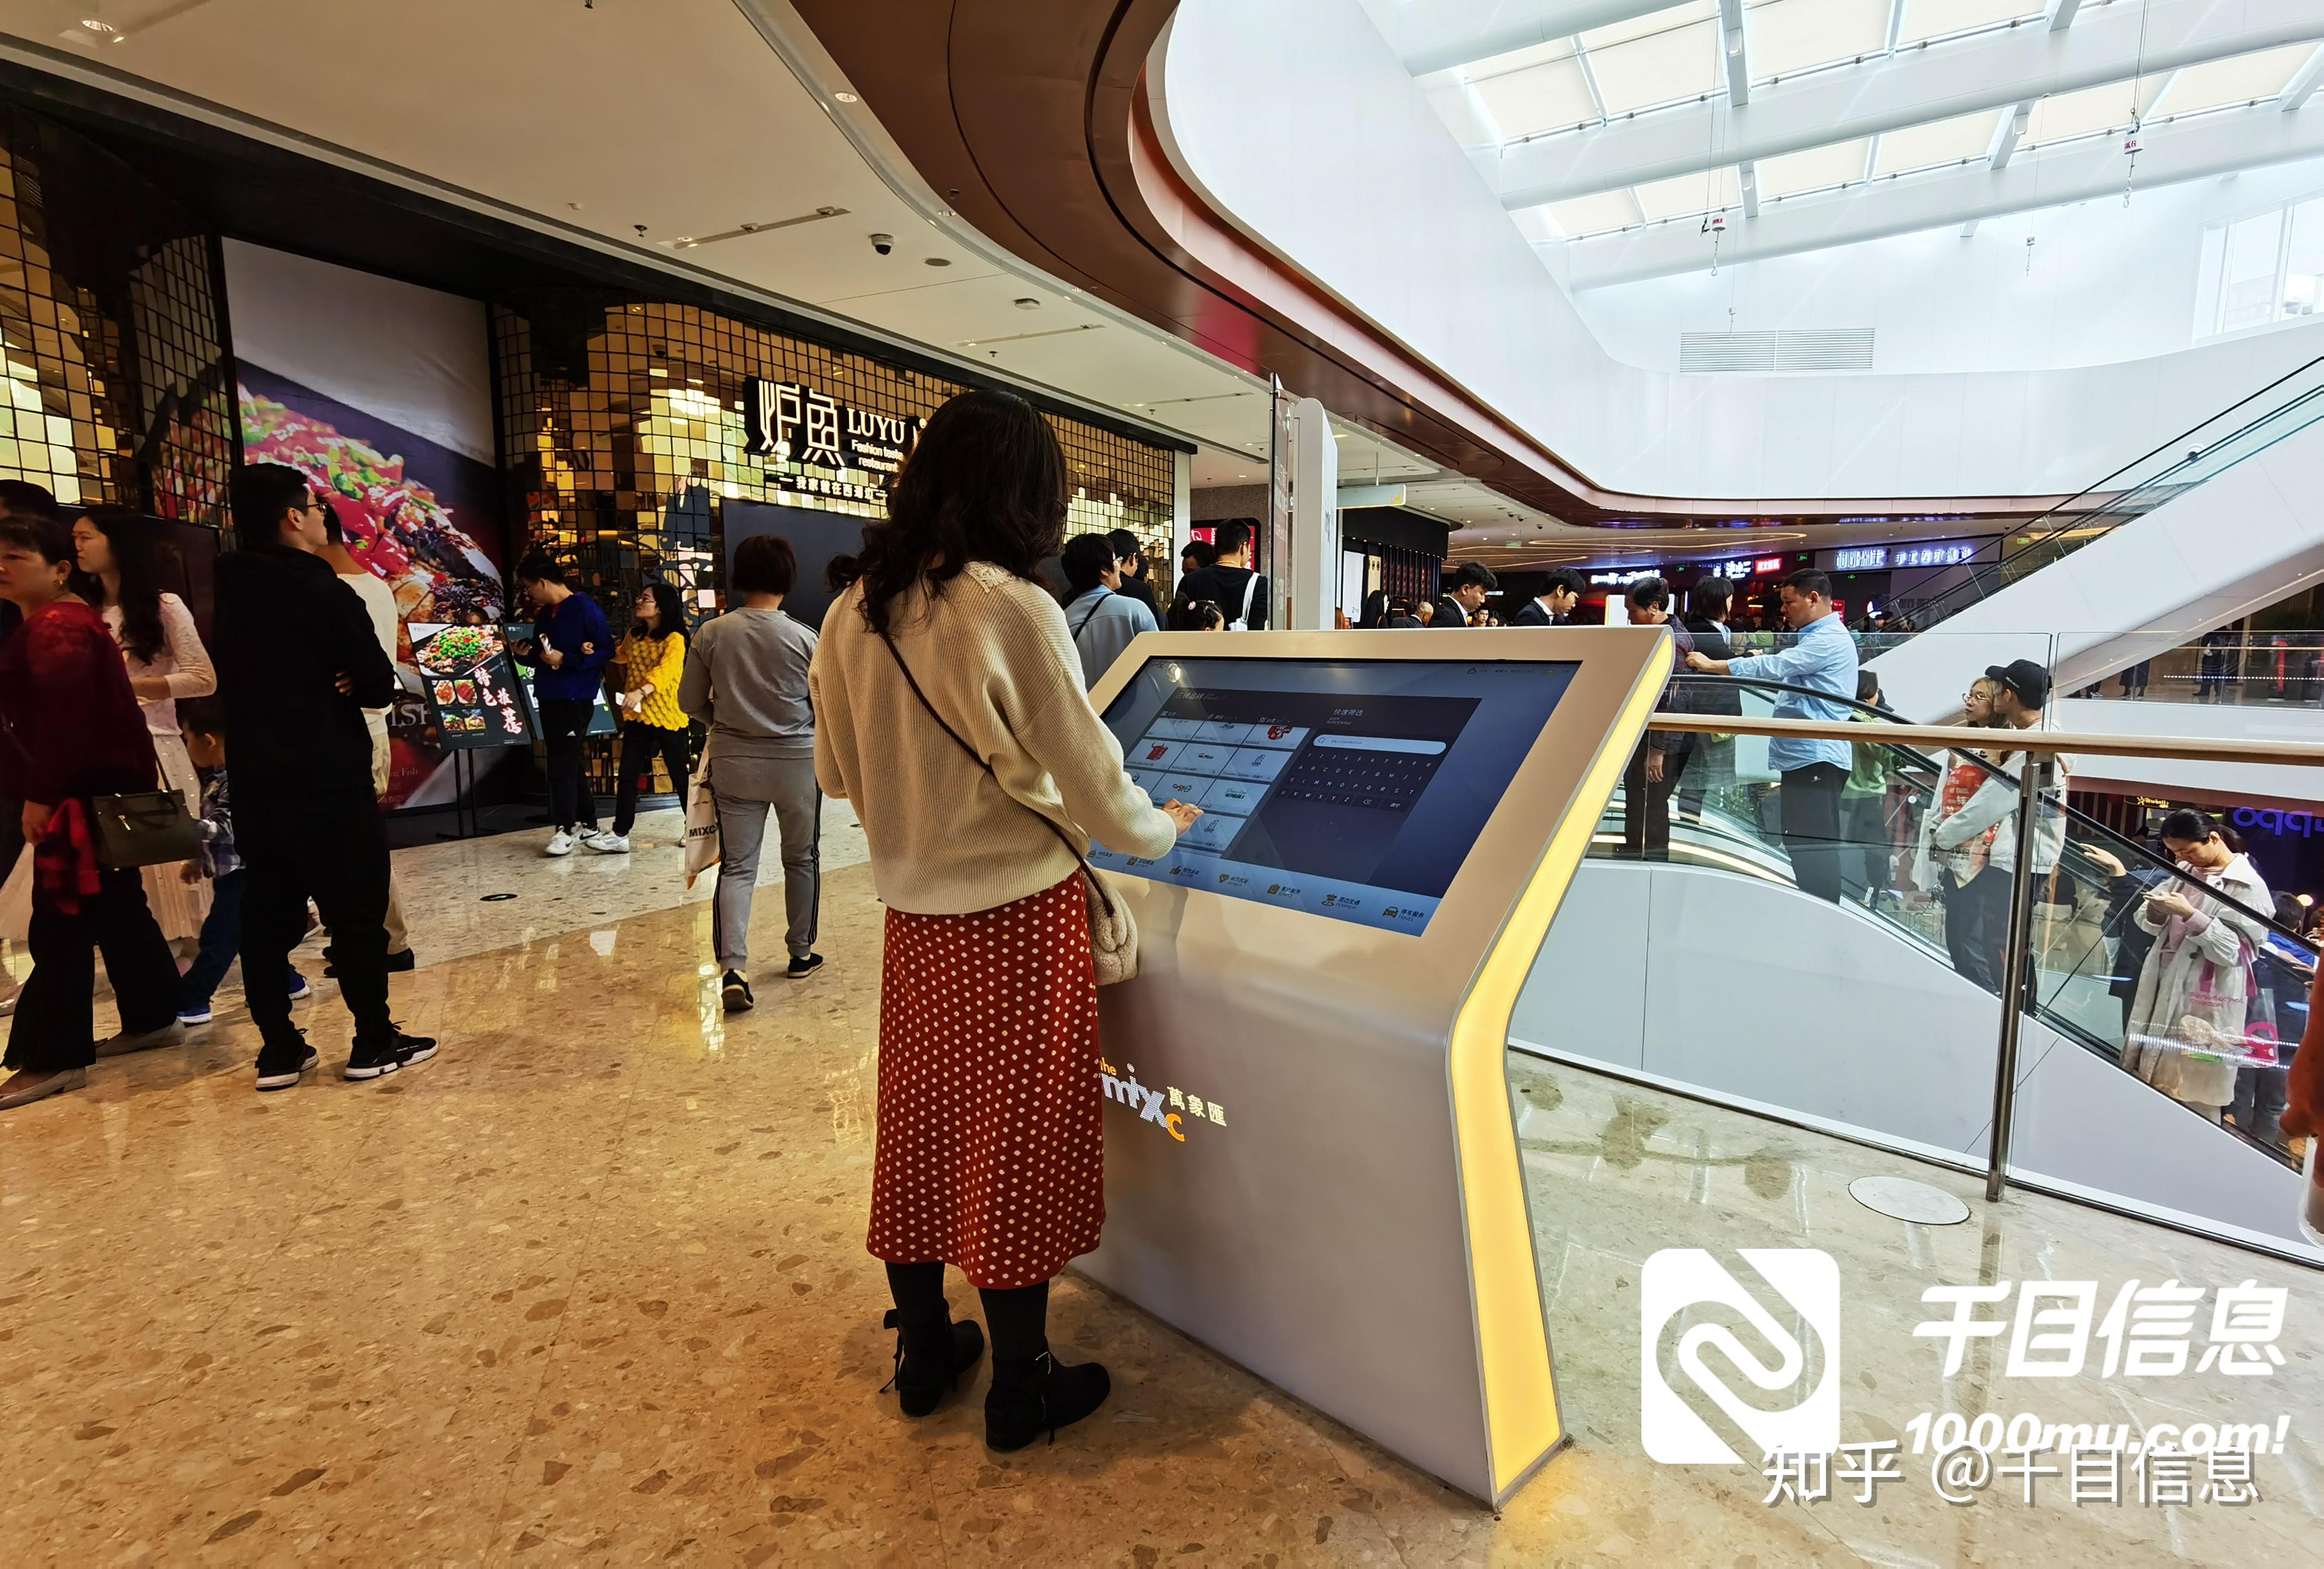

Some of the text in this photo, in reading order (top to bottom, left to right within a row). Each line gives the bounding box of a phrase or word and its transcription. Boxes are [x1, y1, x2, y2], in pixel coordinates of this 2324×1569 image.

[847, 408, 905, 444] LUYU
[852, 439, 904, 461] Fashion taste
[858, 457, 899, 472] restaurant
[796, 475, 874, 500] 我家就在西湖边
[474, 666, 497, 706] 特色
[1333, 708, 1364, 717] 快速筛选
[1338, 896, 1361, 906] 周边交通
[1400, 909, 1425, 919] 停车服务
[1167, 1086, 1227, 1127] 萬象匯
